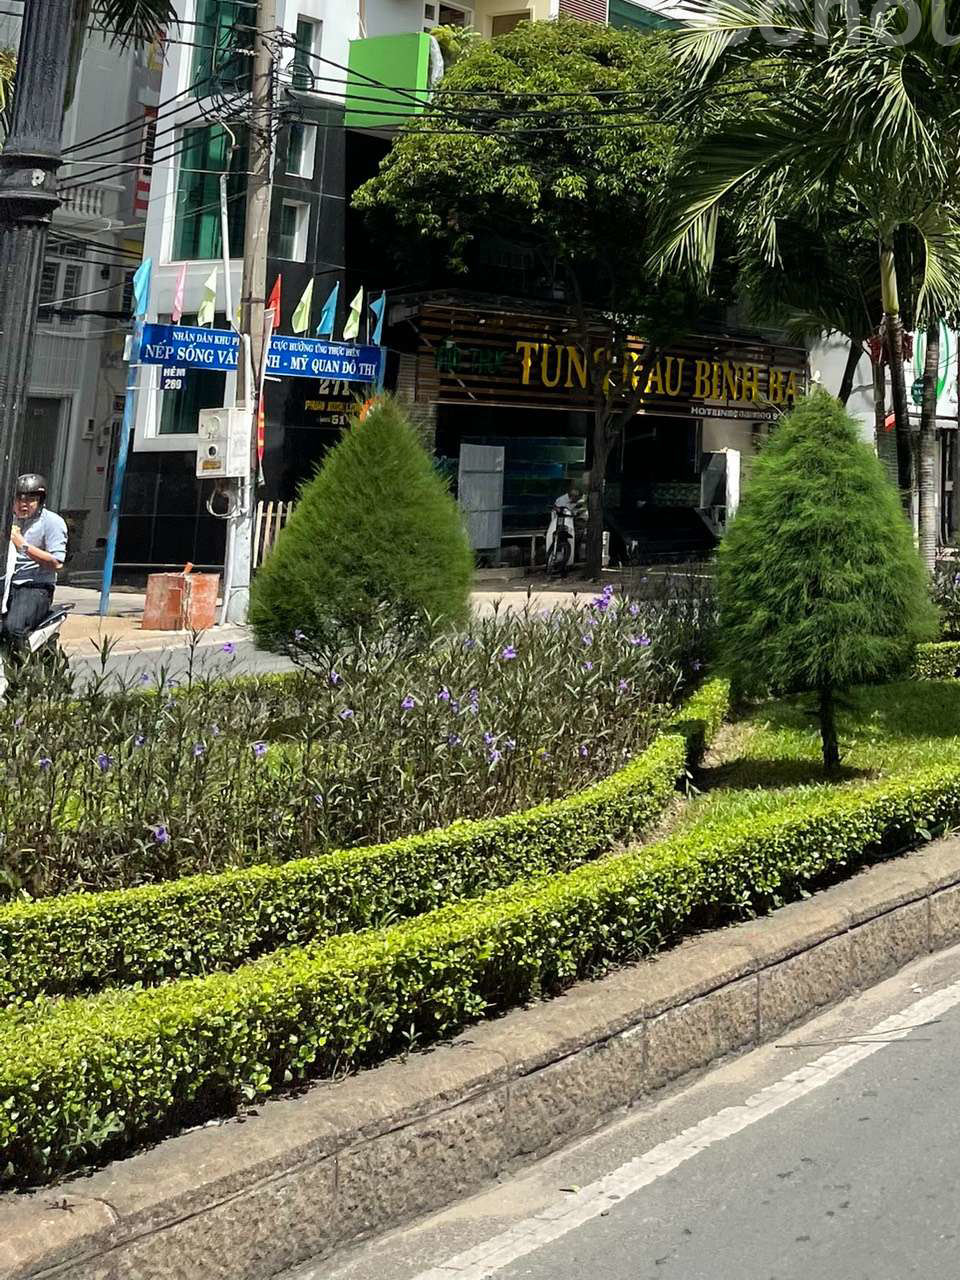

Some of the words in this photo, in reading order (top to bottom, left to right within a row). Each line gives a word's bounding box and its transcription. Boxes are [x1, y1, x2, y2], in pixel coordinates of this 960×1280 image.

[173, 331, 196, 342] NHÂN
[197, 332, 213, 343] DÂN
[214, 335, 231, 345] KHU
[145, 340, 174, 359] NẾP
[177, 343, 214, 363] SỐNG
[290, 354, 309, 370] MỸ
[311, 358, 340, 374] QUAN
[319, 378, 350, 395] 271
